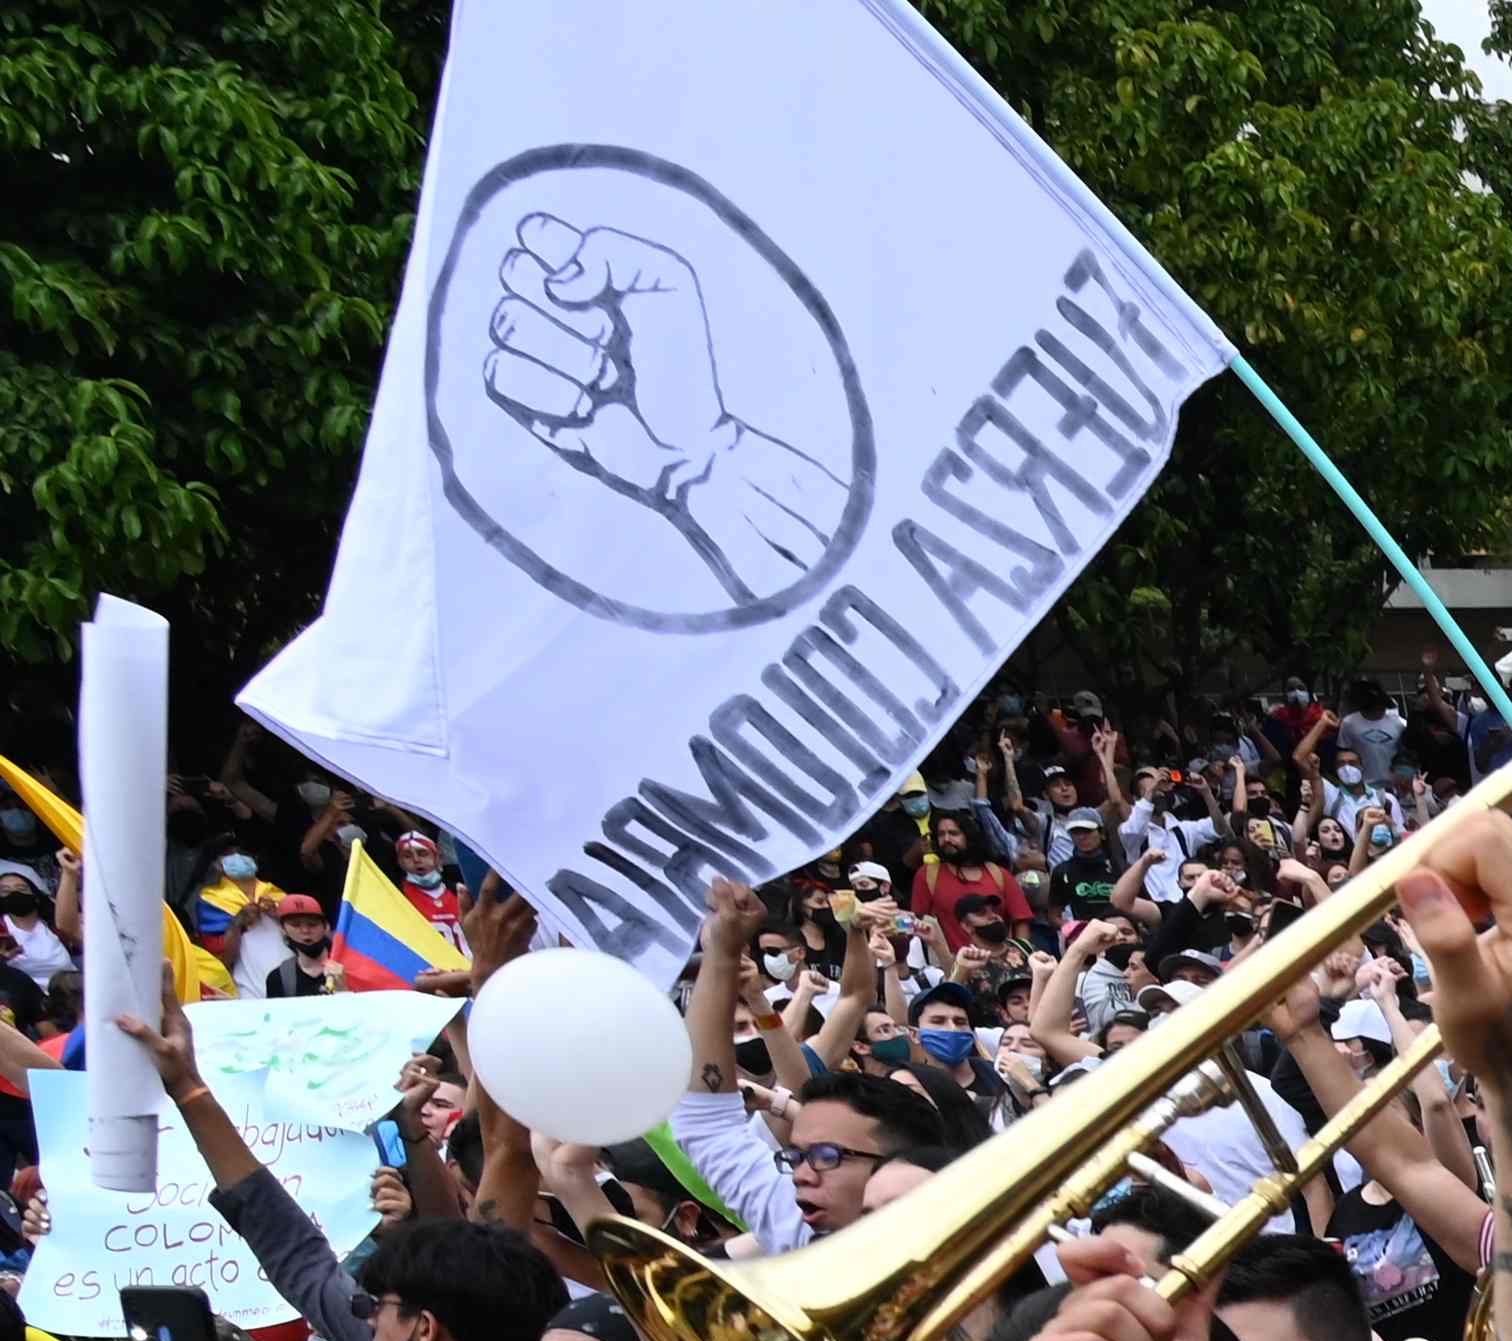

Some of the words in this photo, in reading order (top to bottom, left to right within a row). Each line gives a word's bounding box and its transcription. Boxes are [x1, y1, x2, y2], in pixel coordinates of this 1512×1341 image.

[53, 1268, 102, 1301] es
[114, 1260, 155, 1291] un
[171, 1249, 240, 1293] acto
